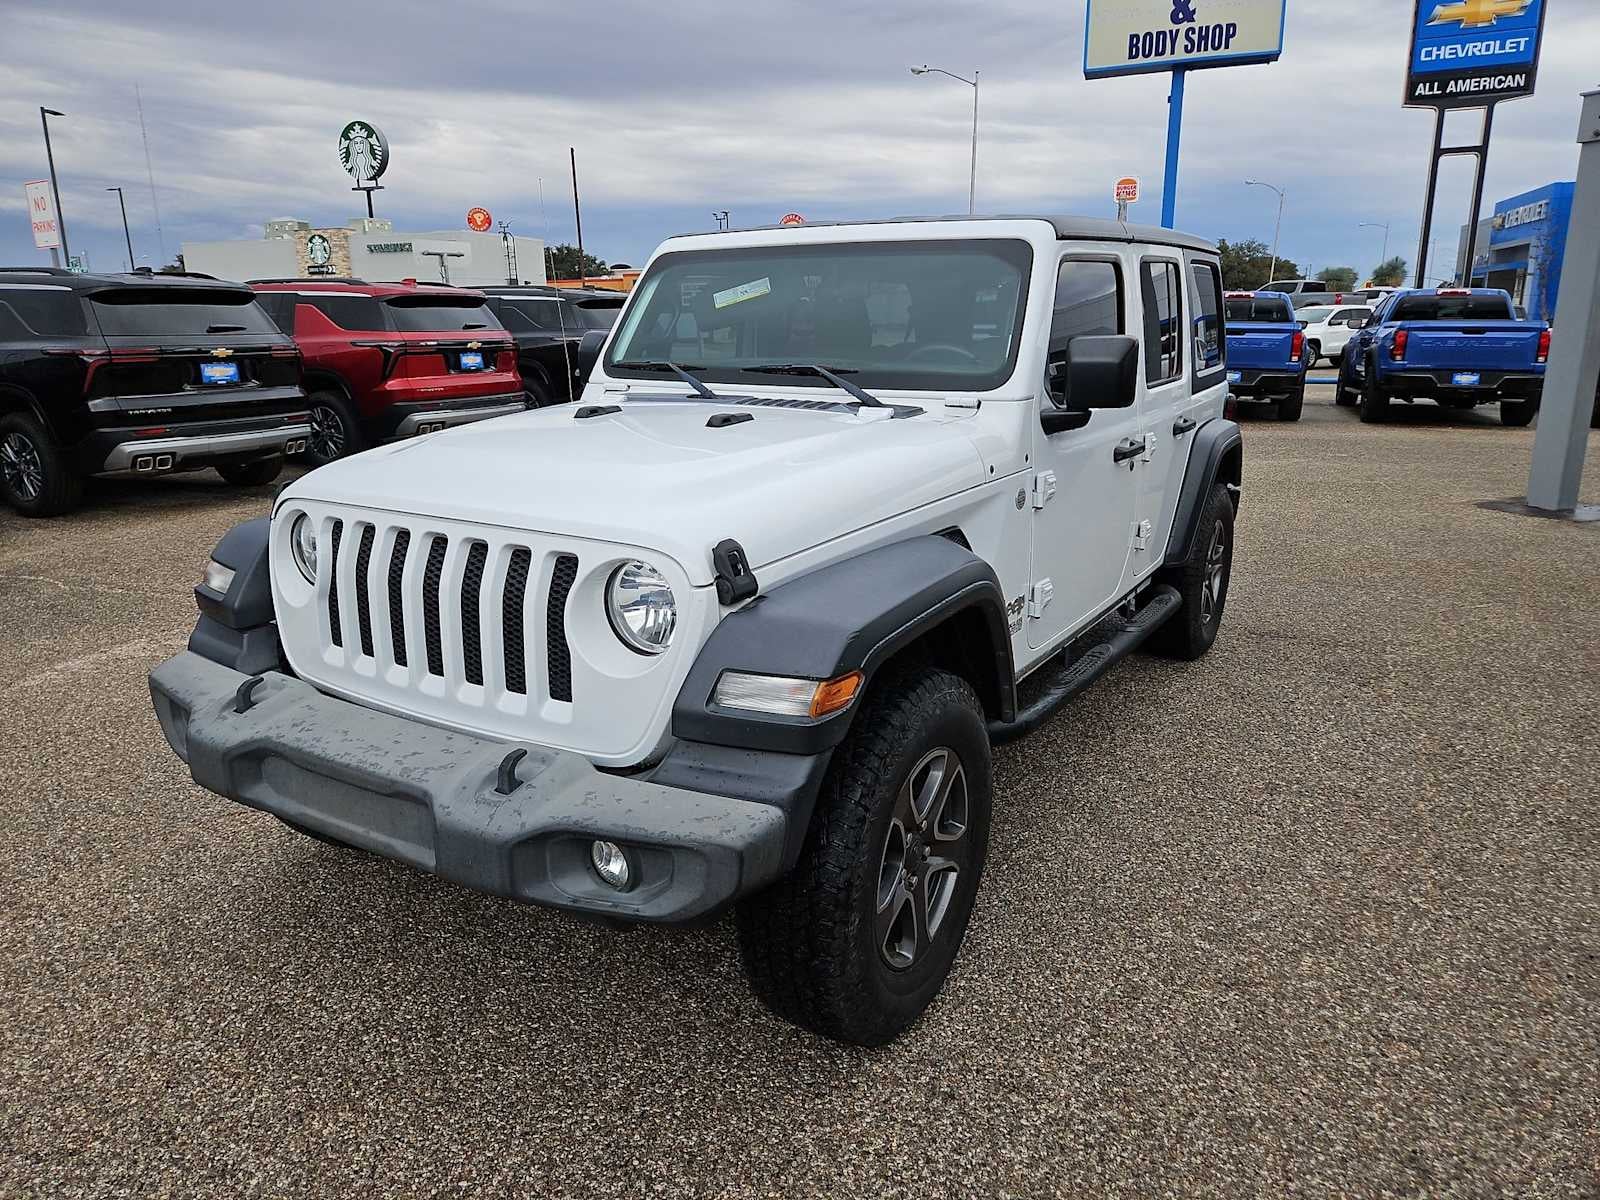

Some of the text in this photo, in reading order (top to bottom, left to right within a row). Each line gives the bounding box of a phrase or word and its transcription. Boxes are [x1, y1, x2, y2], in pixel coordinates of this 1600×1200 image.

[1170, 0, 1196, 25] &
[1127, 22, 1237, 60] BODY SHOP
[1420, 37, 1529, 62] CHEVROLET
[1415, 73, 1526, 96] ALL AMERICAN
[33, 196, 46, 212] NO
[1504, 200, 1549, 229] CHEVROLET
[32, 221, 56, 232] PARKING
